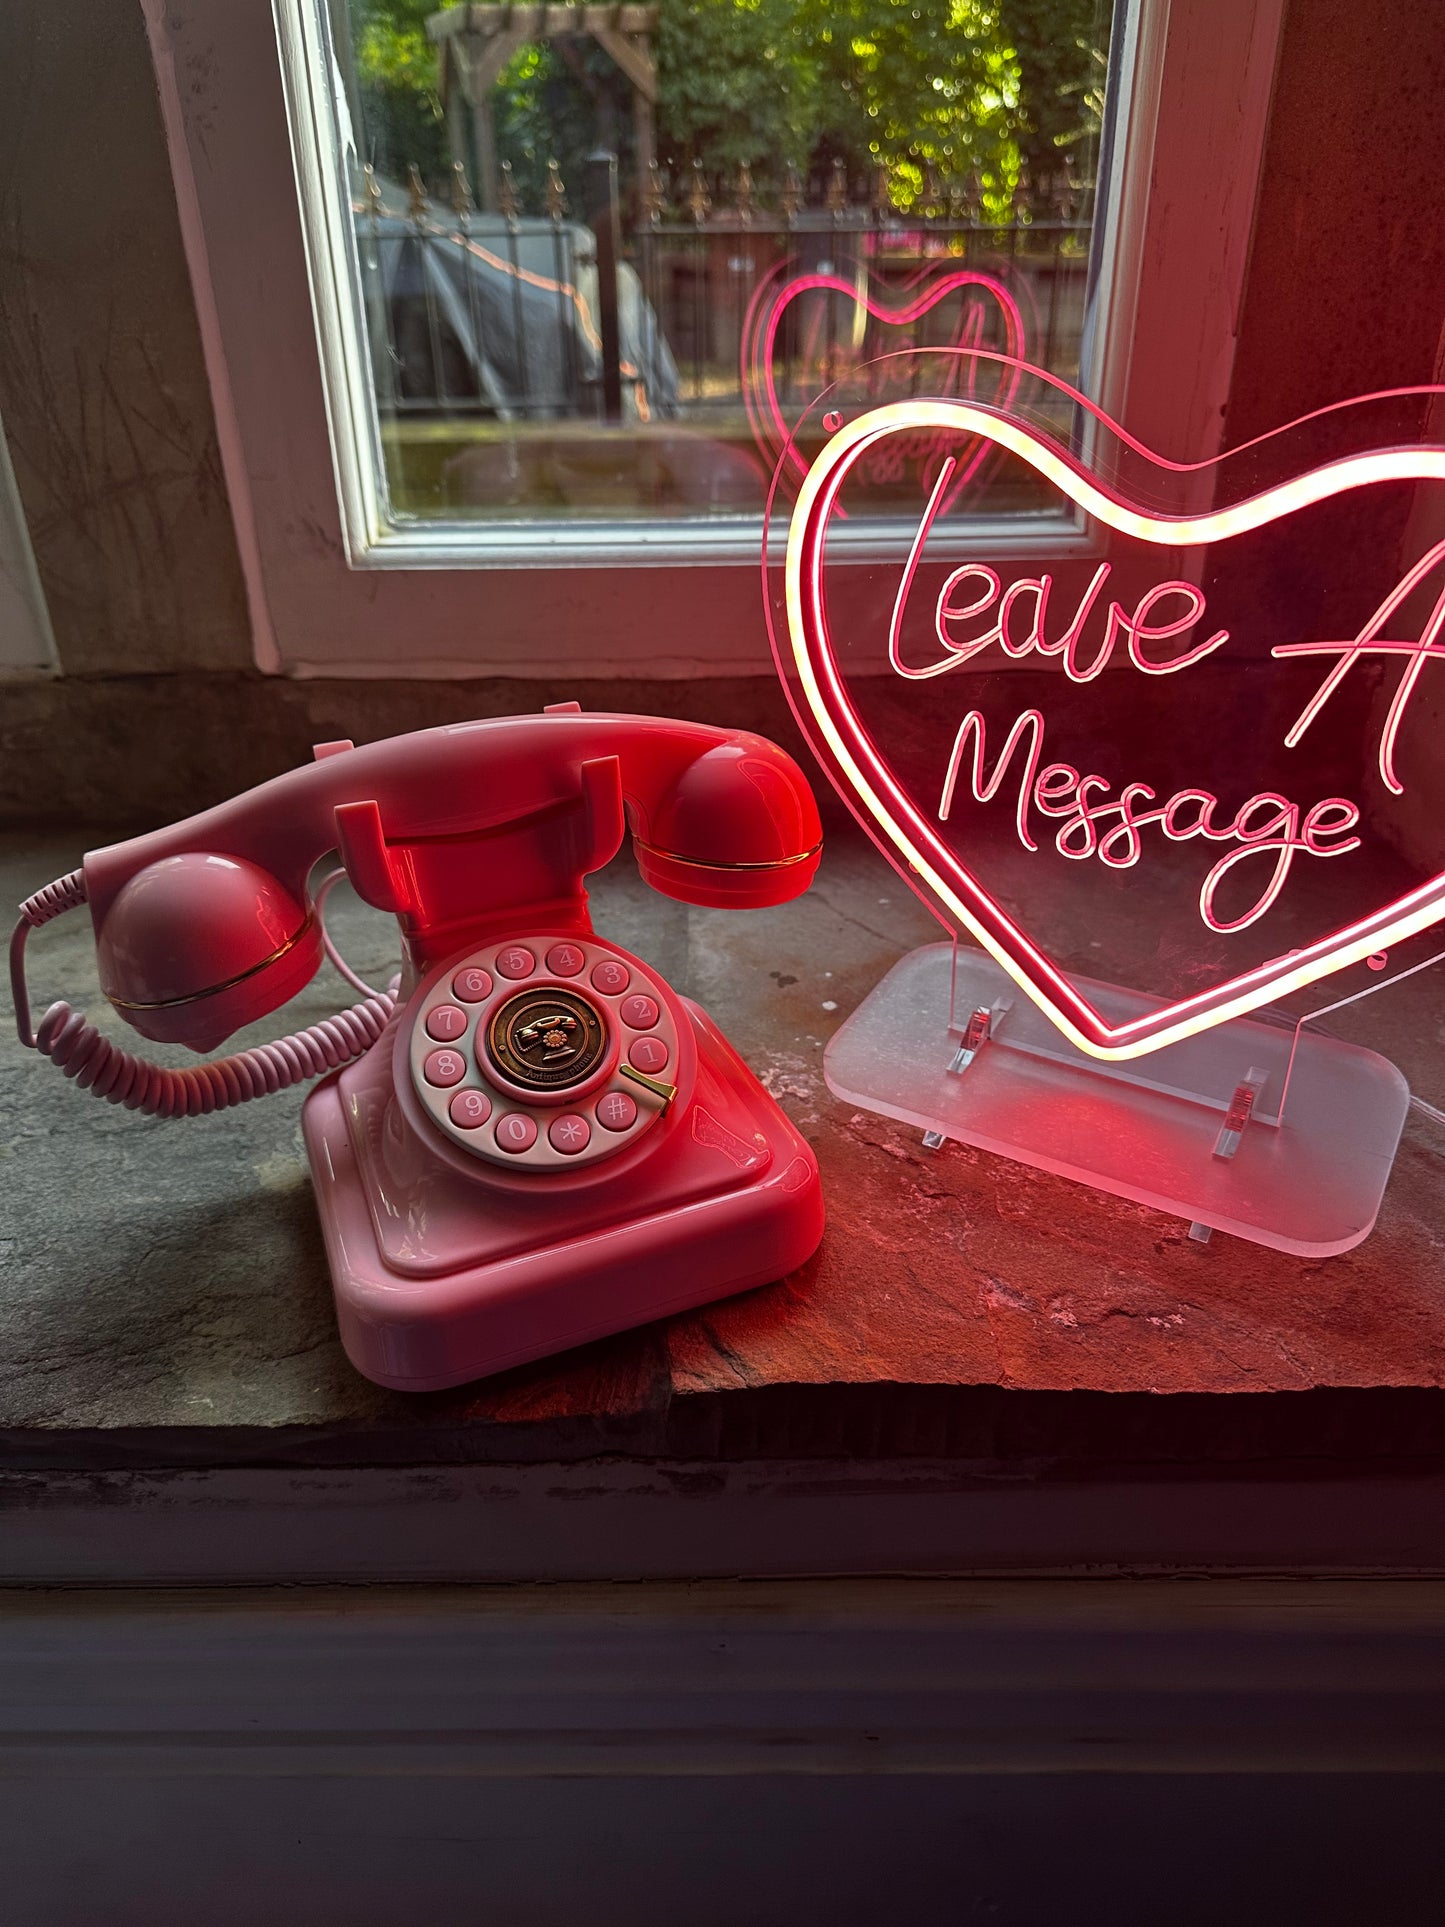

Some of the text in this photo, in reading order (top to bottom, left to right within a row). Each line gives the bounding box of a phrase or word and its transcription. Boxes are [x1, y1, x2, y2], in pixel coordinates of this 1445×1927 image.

[888, 456, 1445, 796] Leave A
[938, 708, 1361, 933] Message
[509, 952, 525, 970] 5
[559, 949, 576, 967] 4
[466, 973, 483, 991] 6
[604, 966, 621, 984] 3
[633, 1000, 651, 1019] 2
[438, 1011, 452, 1030] 7
[642, 1045, 658, 1064] 1
[437, 1056, 456, 1076] 8
[465, 1096, 484, 1117] 9
[607, 1098, 629, 1121] #
[508, 1119, 527, 1140] 0
